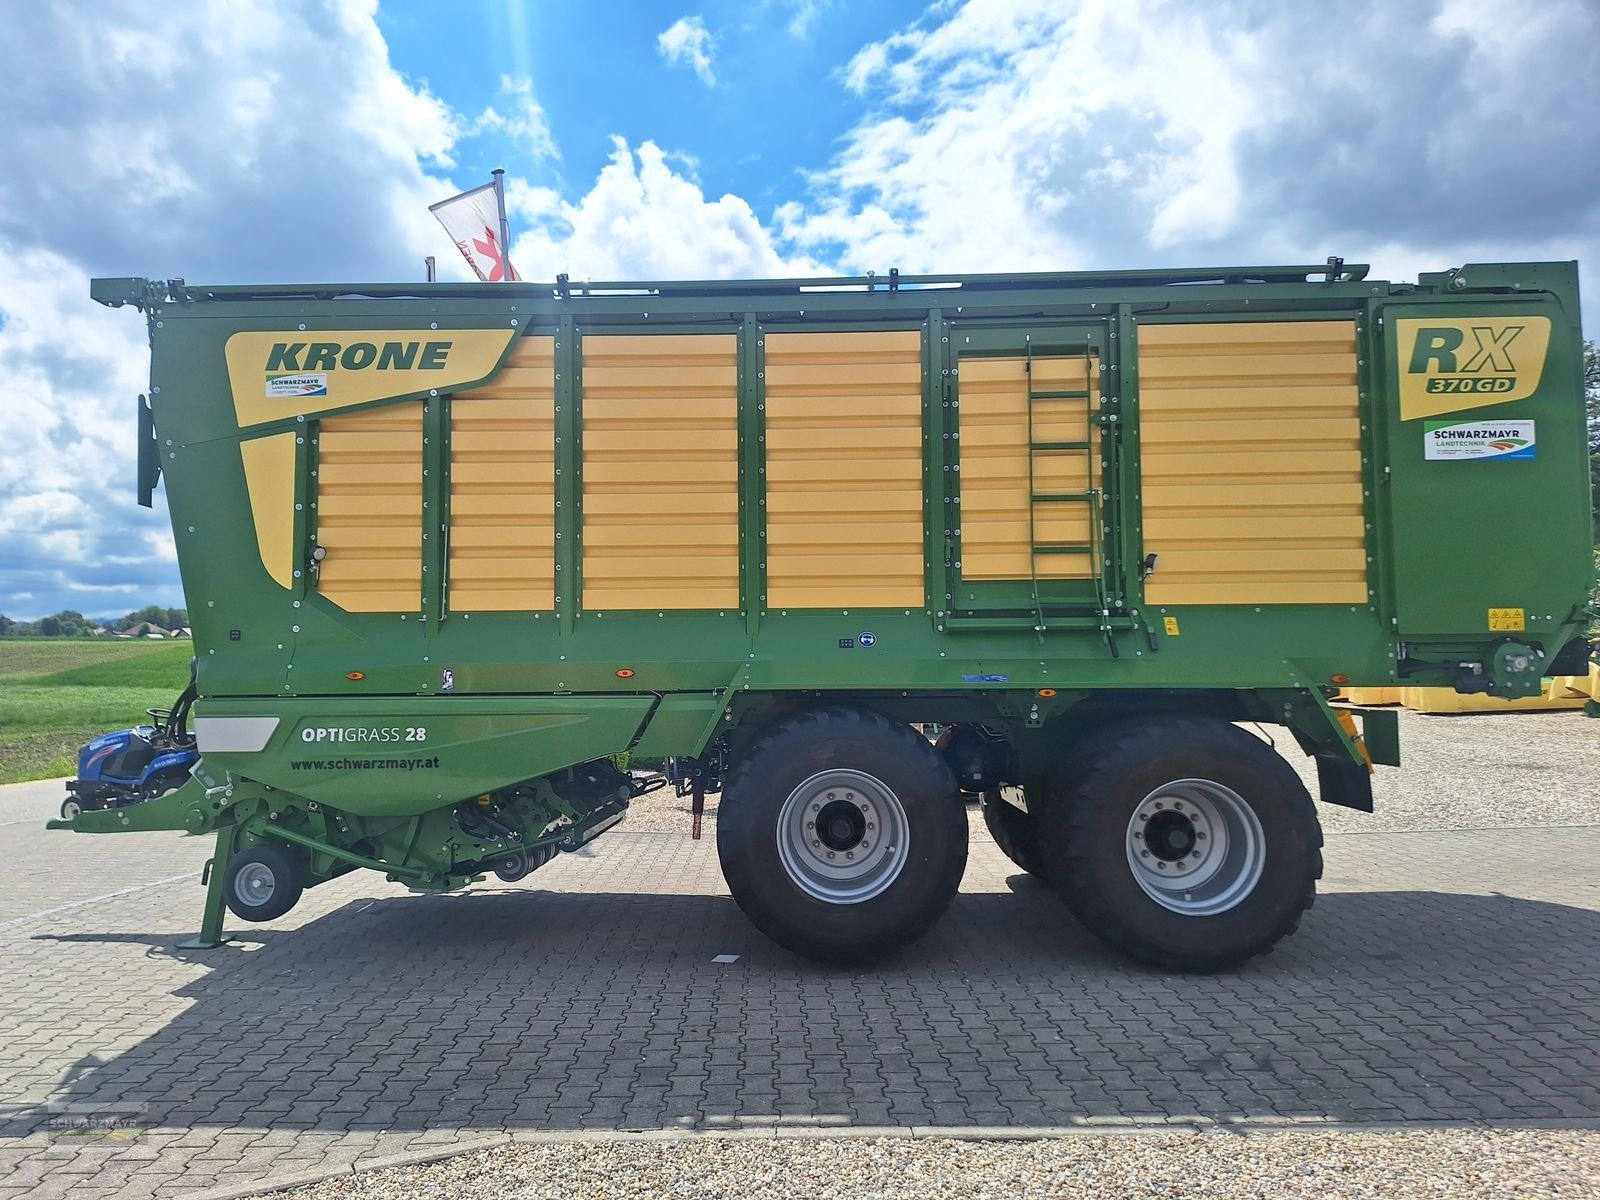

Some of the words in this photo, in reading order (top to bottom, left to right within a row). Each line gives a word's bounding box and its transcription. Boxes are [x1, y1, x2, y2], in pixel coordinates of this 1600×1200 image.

[264, 342, 452, 371] KRONE
[1408, 326, 1525, 373] RX
[1431, 379, 1473, 392] 370
[1476, 379, 1510, 392] GD
[1434, 430, 1520, 439] SCHWARZMAYR
[301, 728, 400, 742] OPTIGRASS
[405, 728, 427, 741] 28
[290, 756, 440, 772] www.schwarzmayr.at
